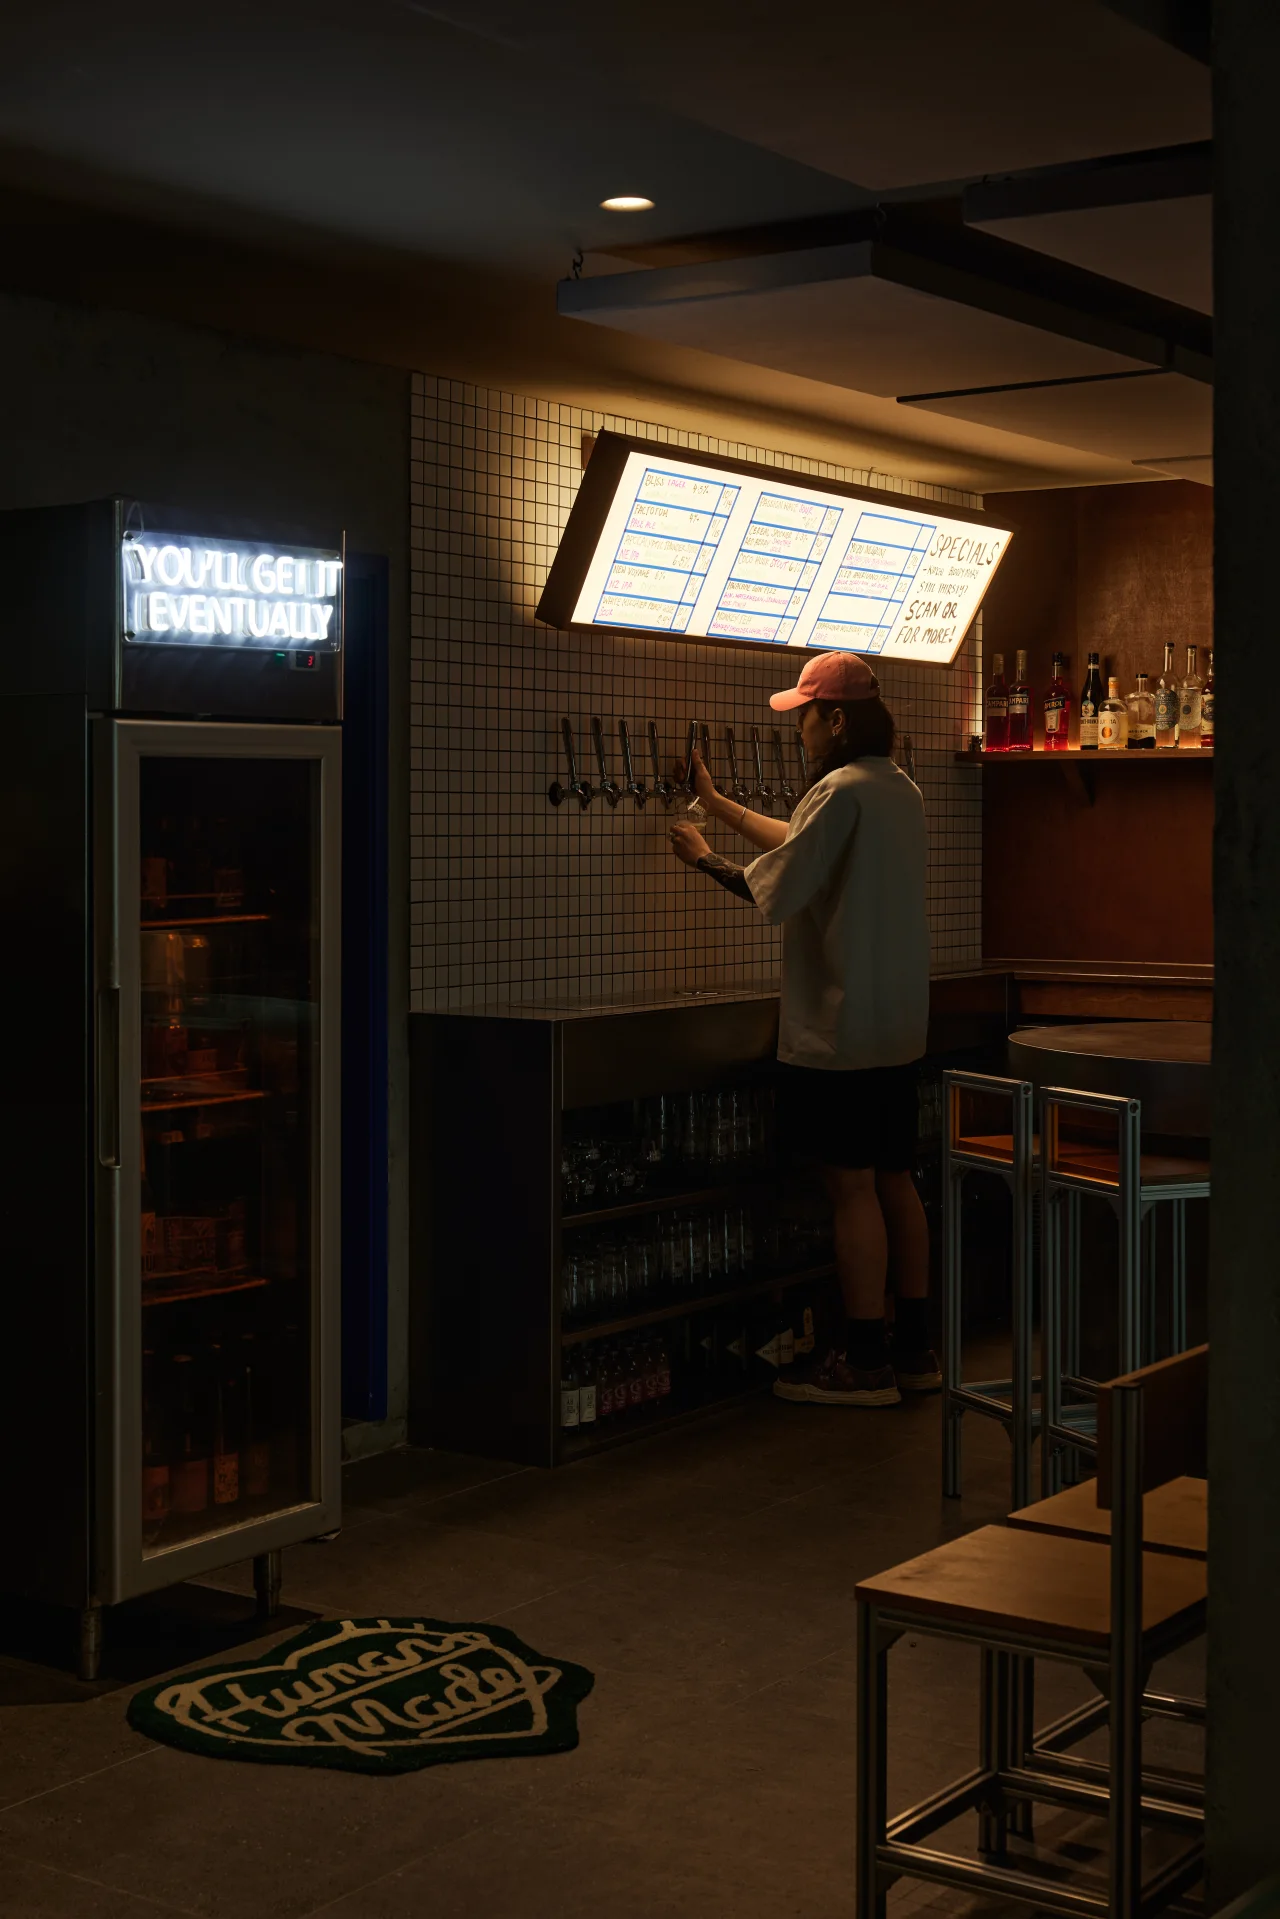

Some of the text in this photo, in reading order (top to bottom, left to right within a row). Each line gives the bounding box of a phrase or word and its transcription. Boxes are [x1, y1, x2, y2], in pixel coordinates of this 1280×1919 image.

[645, 474, 664, 486] BLISS
[634, 504, 668, 517] FACTOTUM
[930, 534, 999, 565] SPECIALS
[133, 544, 248, 591] YOU'LL
[314, 561, 343, 598] IT
[613, 565, 626, 575] NEW
[770, 558, 789, 569] STOUT
[621, 581, 632, 590] IPA
[917, 581, 968, 597] STILL THIRSTY?
[149, 592, 333, 640] EVENTUALLY
[905, 600, 958, 621] SCAN QR
[895, 625, 921, 644] FOR
[922, 626, 956, 644] MORE!
[155, 1632, 492, 1733] Human
[282, 1664, 540, 1756] Made
